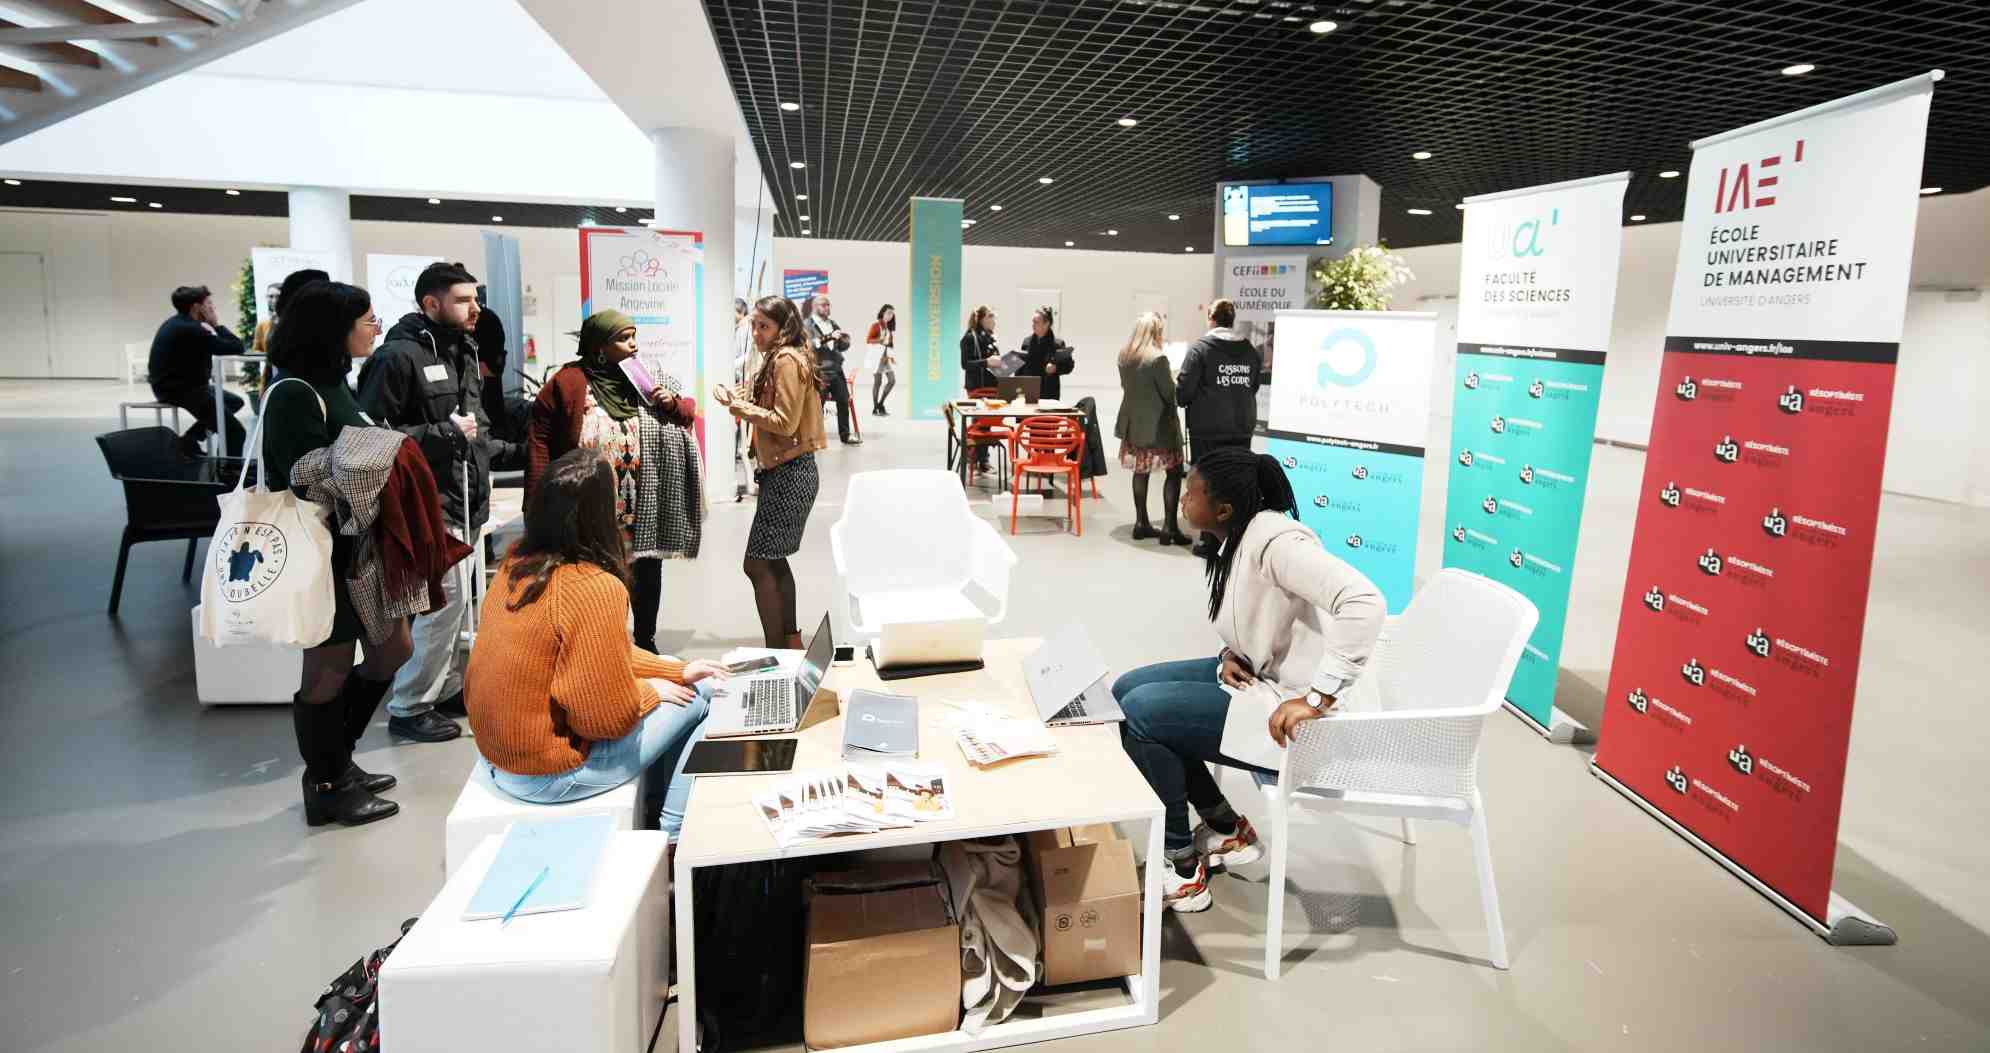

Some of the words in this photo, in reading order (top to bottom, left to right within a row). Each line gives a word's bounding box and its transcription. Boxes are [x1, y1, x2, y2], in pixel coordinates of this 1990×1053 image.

[1711, 225, 1760, 245] ÉCOLE
[1707, 239, 1838, 265] UNIVERSITAIRE
[1704, 272, 1723, 287] DE
[1729, 263, 1867, 286] MANAGEMENT
[1239, 286, 1269, 297] ÉCOLE
[1271, 287, 1286, 297] DU
[1484, 290, 1505, 302] DES
[1509, 289, 1570, 302] SCIENCES
[928, 256, 943, 381] RECONVERSION
